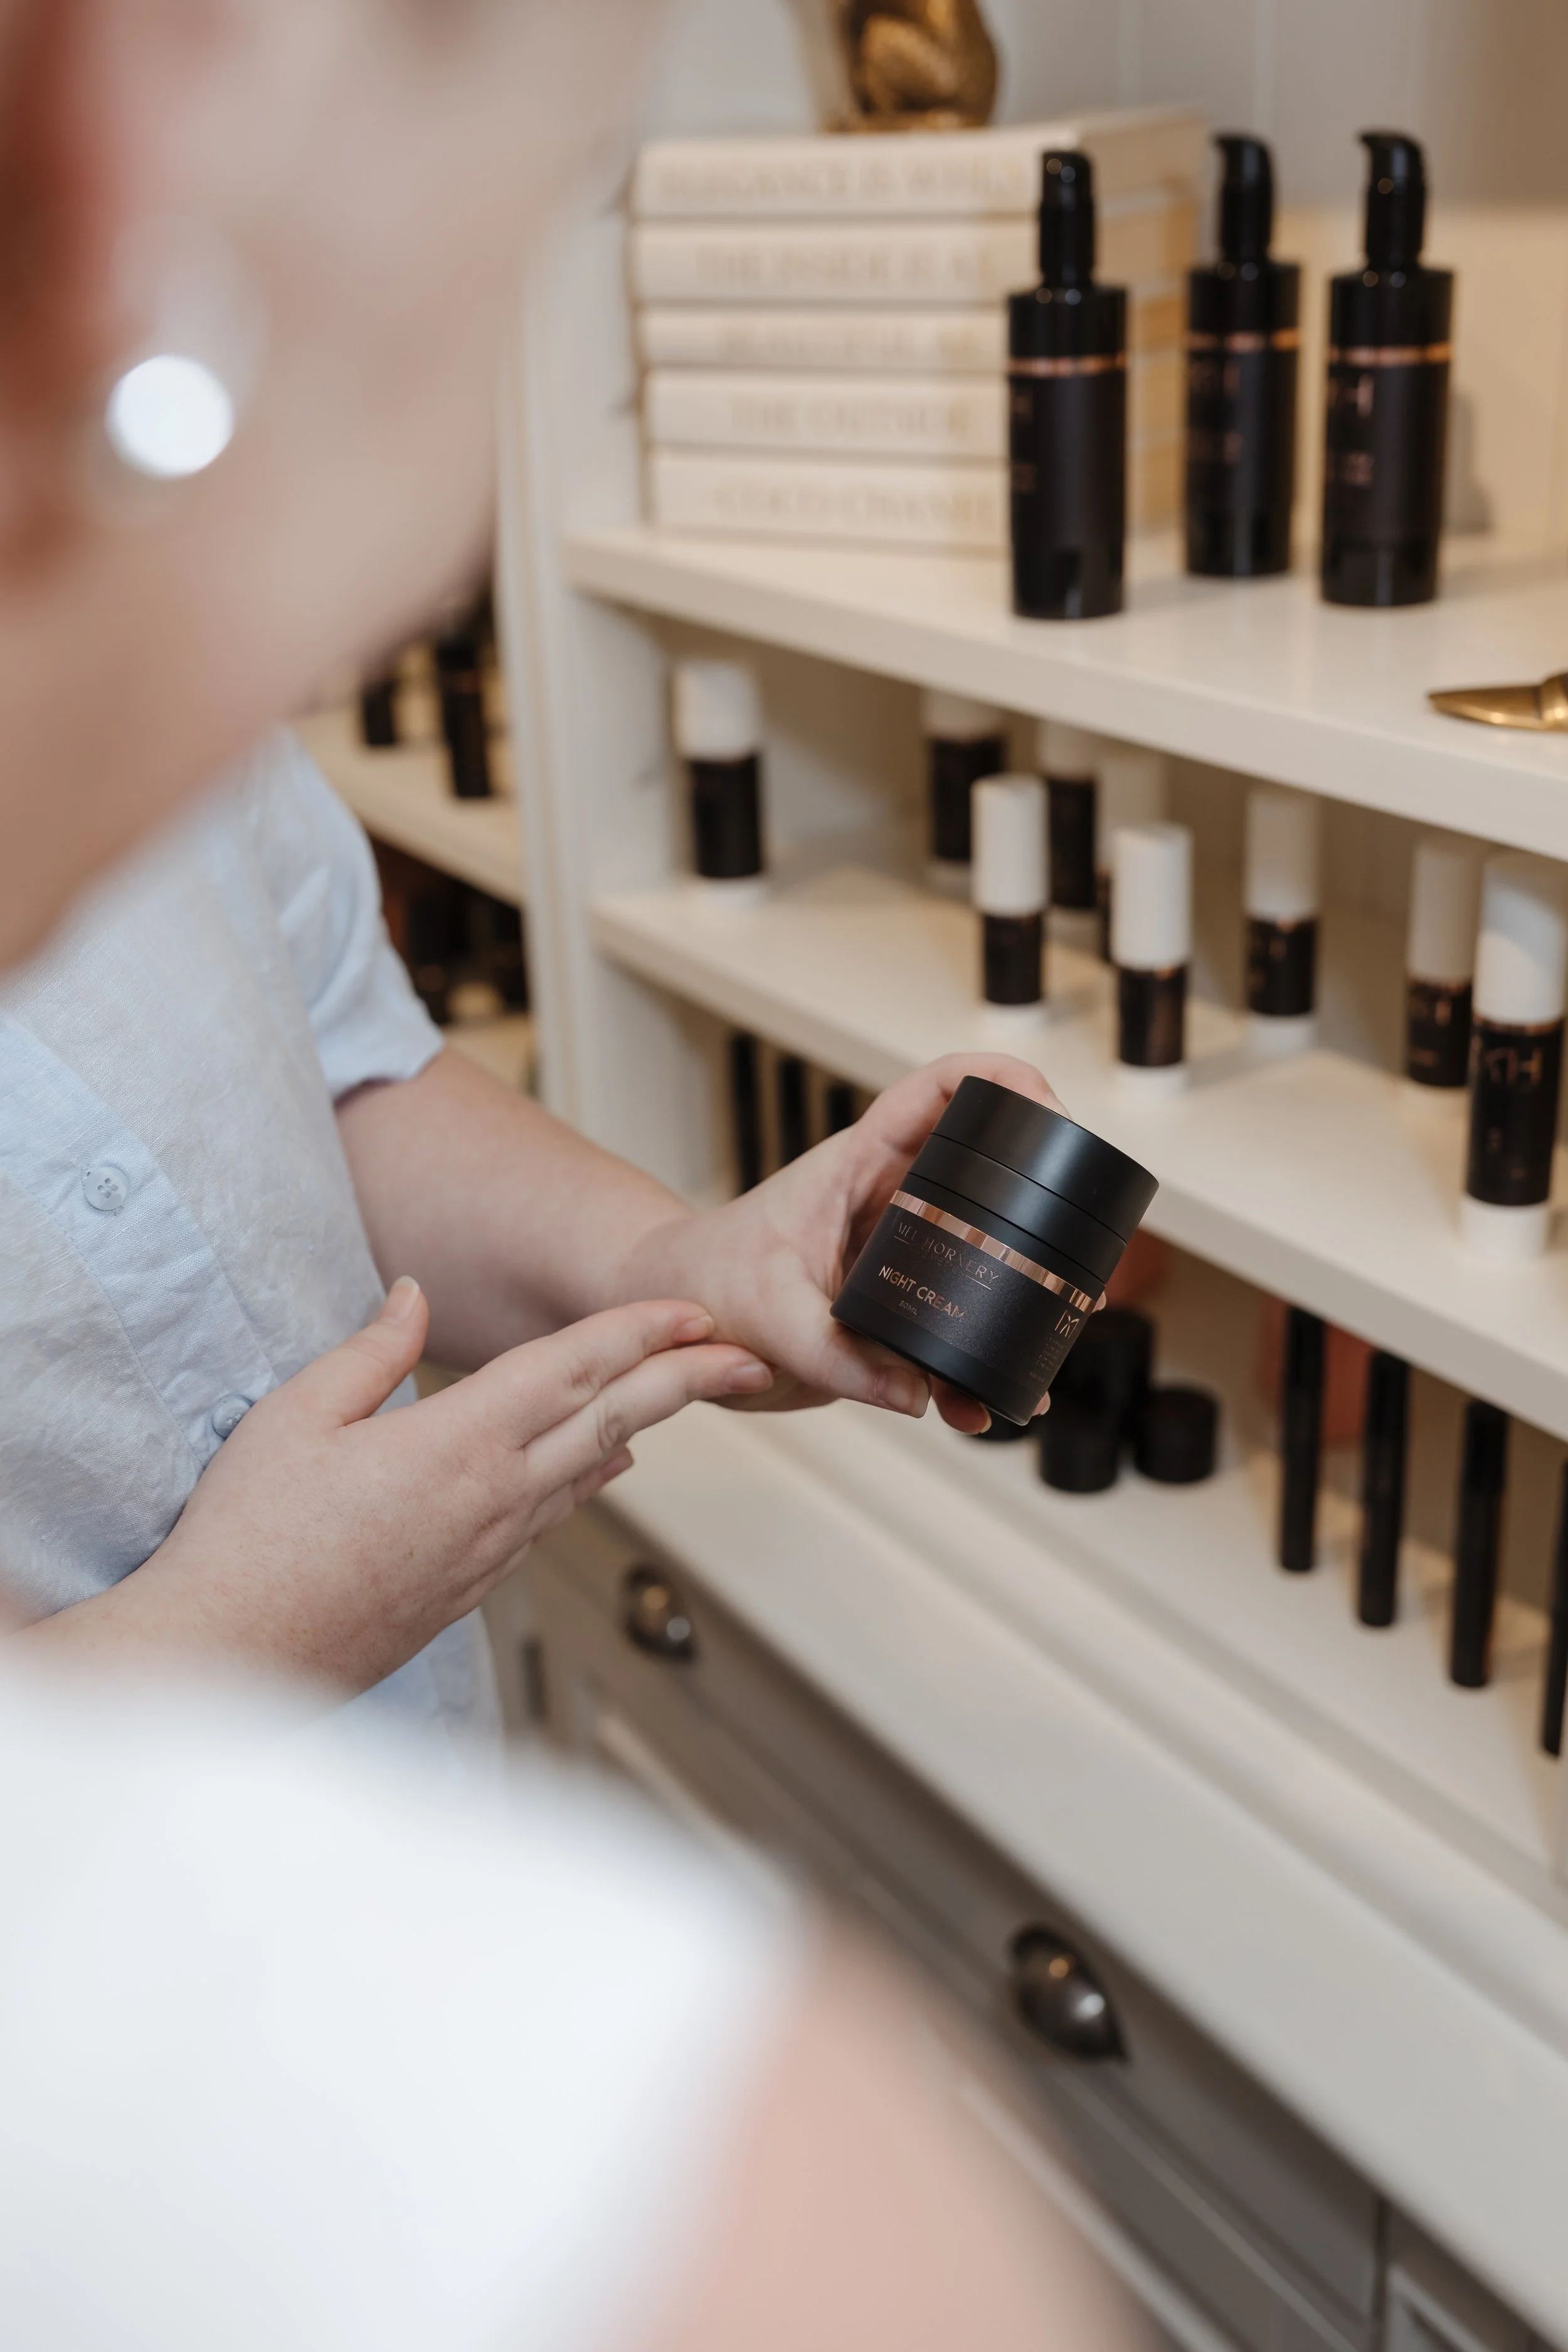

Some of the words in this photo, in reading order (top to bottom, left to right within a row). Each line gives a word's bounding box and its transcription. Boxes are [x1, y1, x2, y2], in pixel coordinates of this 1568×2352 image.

[924, 1237, 999, 1283] HORNERY
[878, 1265, 917, 1292] NIGHT
[916, 1286, 967, 1318] CREAM
